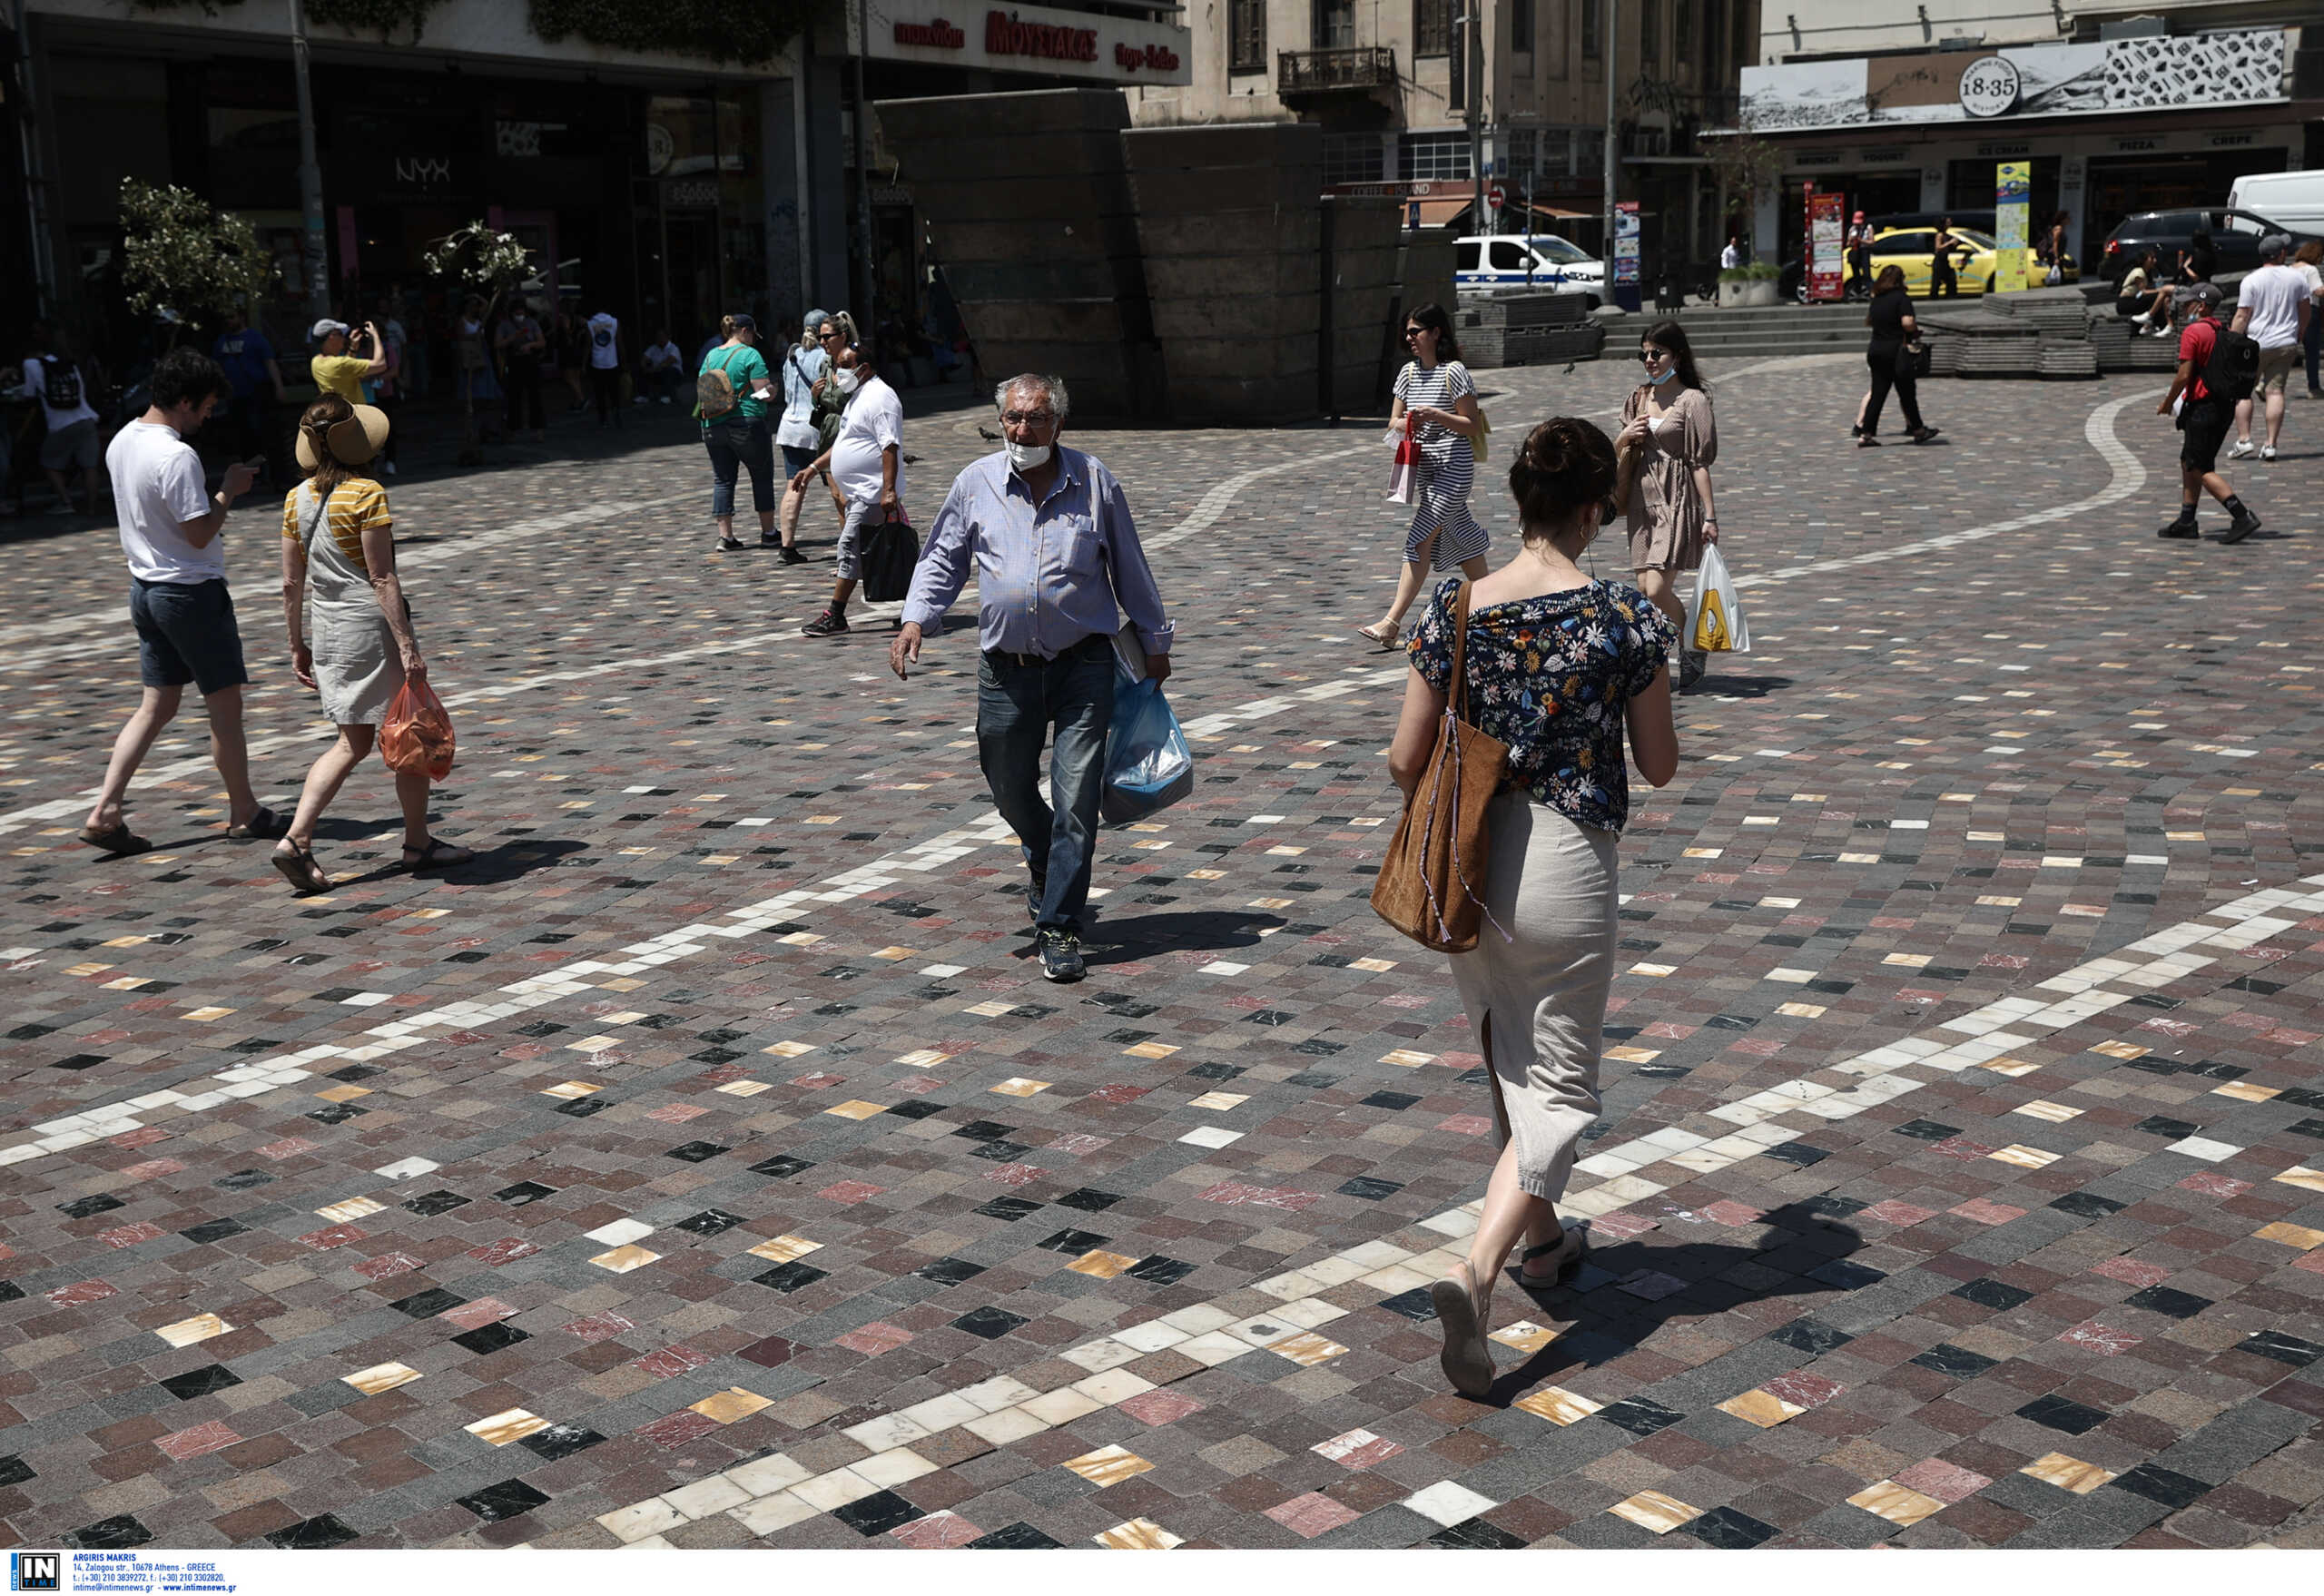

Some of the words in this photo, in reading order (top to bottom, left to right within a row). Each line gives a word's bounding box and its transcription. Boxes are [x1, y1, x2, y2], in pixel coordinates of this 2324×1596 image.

[2212, 135, 2252, 146] CREPE
[1977, 146, 1993, 156] ICE
[1994, 144, 2029, 155] CREAM
[2119, 141, 2155, 151] PIZZA
[1796, 155, 1839, 165] BRUNCH
[1863, 153, 1905, 163] YOGURT
[394, 156, 450, 182] NYX
